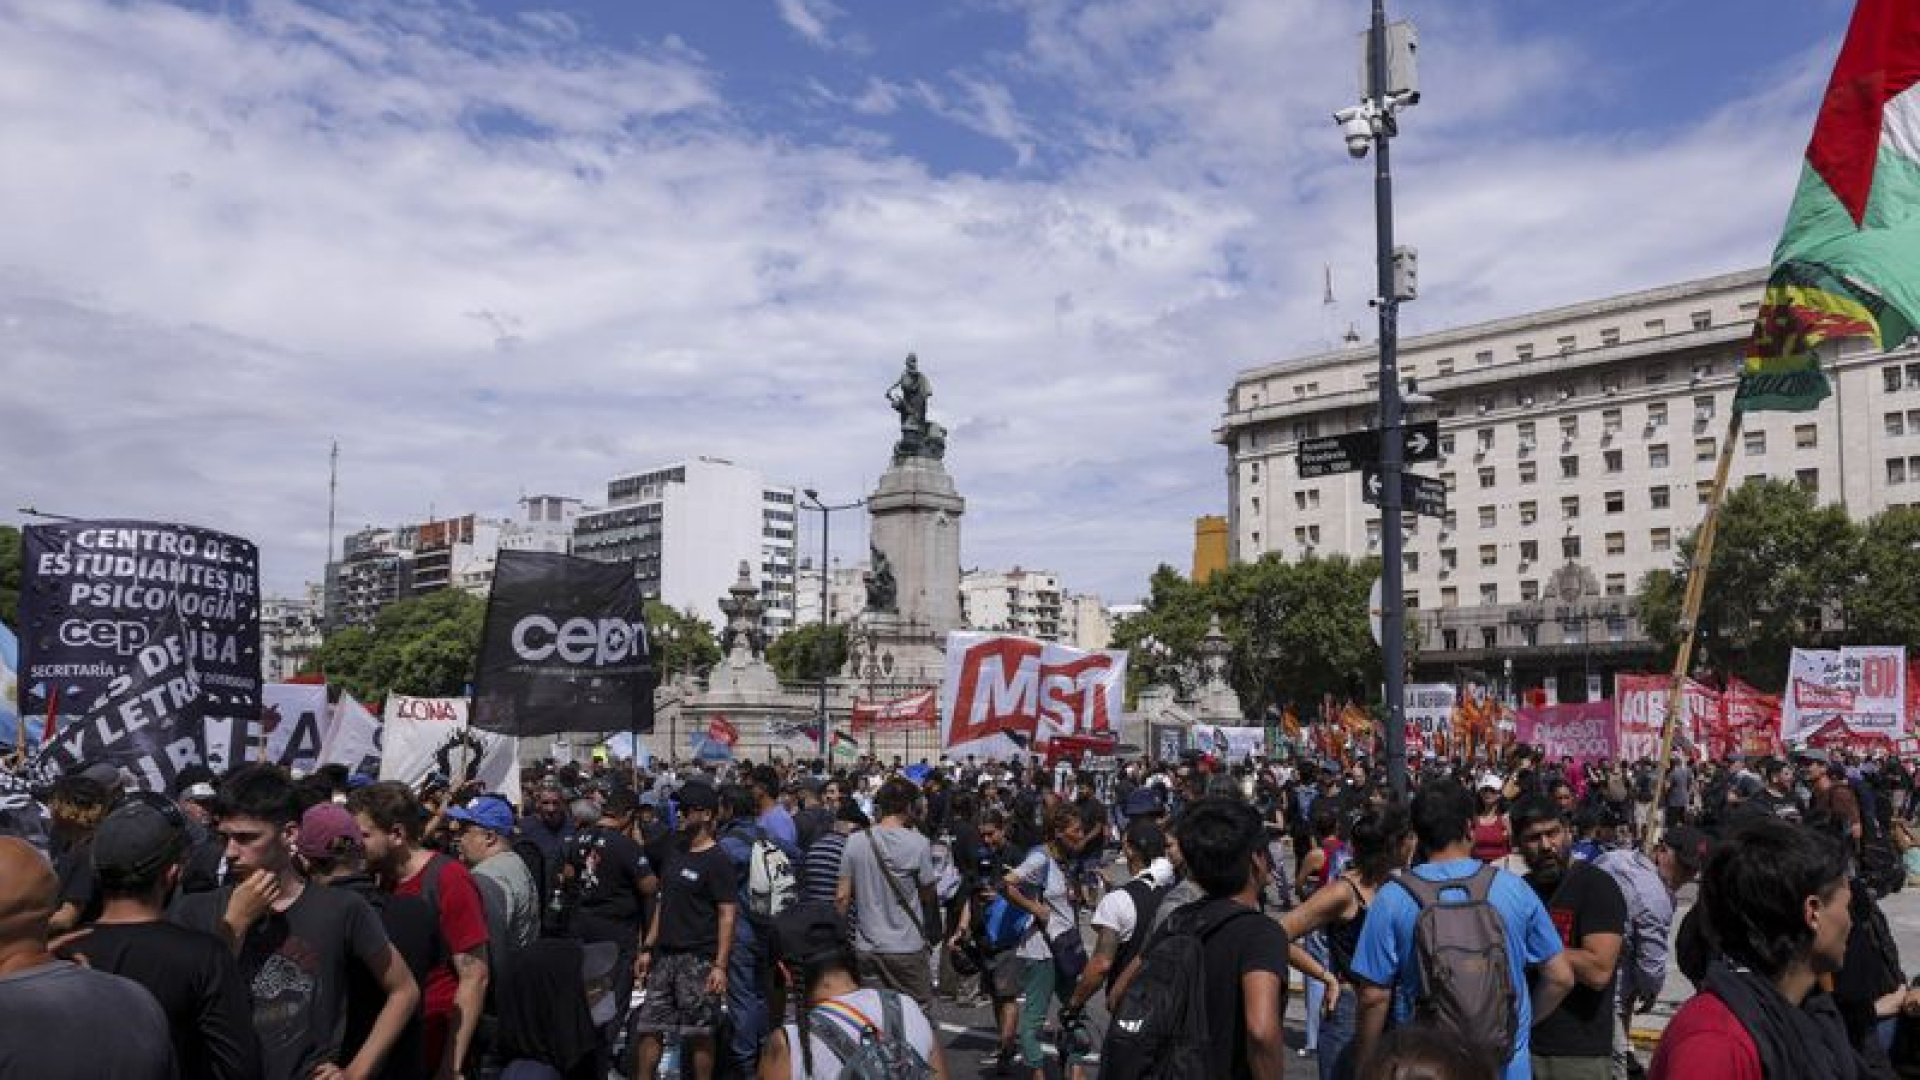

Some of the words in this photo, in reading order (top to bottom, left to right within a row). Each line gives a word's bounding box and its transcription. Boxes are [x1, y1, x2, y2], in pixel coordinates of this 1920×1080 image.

[76, 529, 197, 556] CENTRO
[203, 539, 231, 562] DE
[38, 552, 228, 589] ESTUDIANTES
[233, 572, 254, 595] DE
[138, 635, 184, 677] DE
[966, 650, 1115, 738] MST
[63, 729, 85, 764] Y
